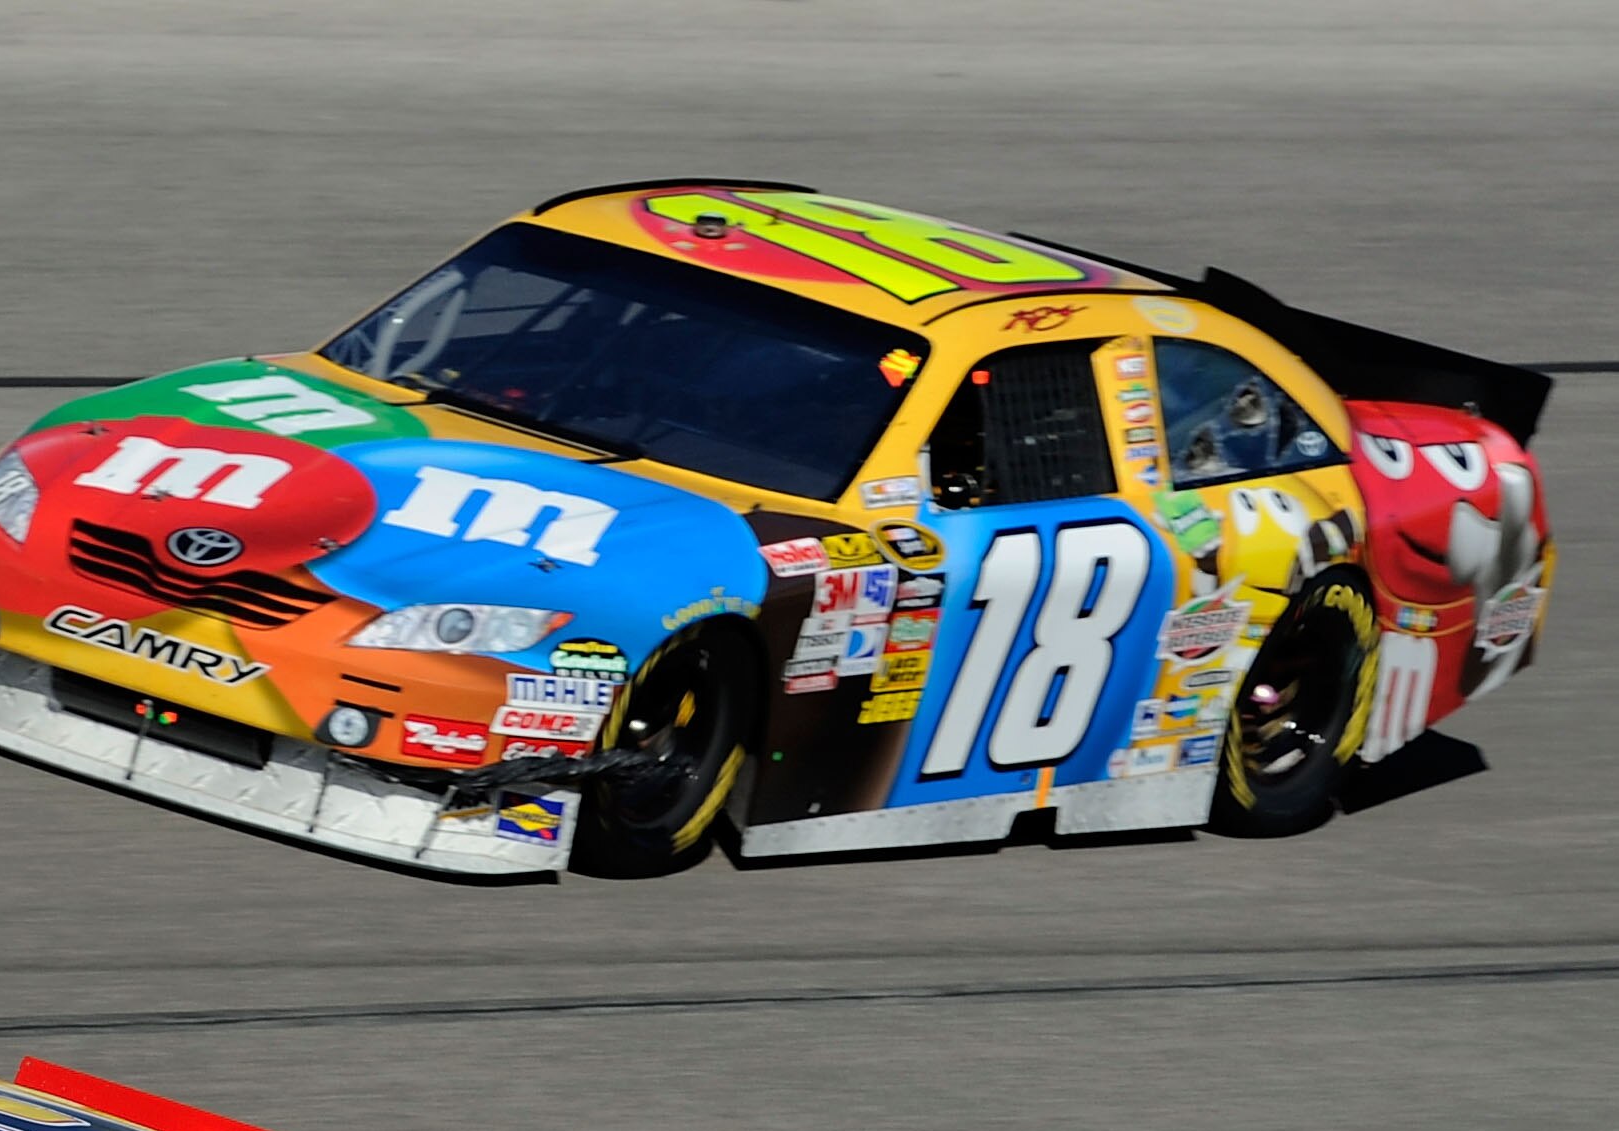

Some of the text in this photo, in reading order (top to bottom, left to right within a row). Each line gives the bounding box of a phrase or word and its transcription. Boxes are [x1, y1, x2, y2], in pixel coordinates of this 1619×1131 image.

[643, 190, 1091, 304] 18
[178, 375, 376, 436] m
[73, 436, 293, 509] m
[381, 465, 619, 567] m
[44, 605, 271, 686] CAMRY
[917, 517, 1150, 783] 18
[501, 710, 575, 730] COMP
[512, 676, 611, 706] MAHLE
